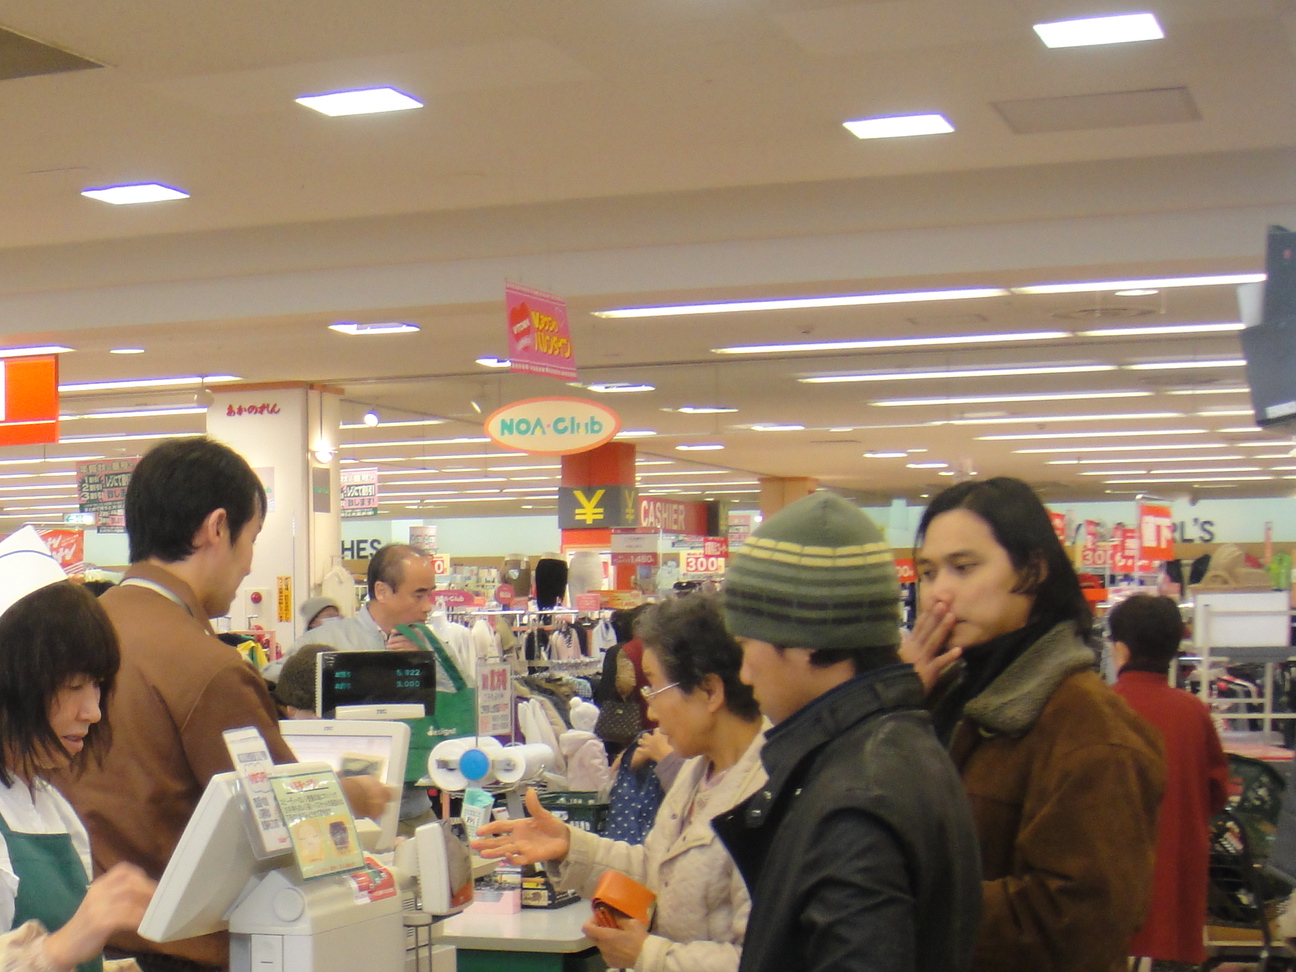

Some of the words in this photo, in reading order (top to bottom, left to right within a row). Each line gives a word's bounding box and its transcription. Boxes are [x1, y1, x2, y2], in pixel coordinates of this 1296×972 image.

[226, 402, 281, 417] あかのれん
[640, 499, 686, 531] CASHIER
